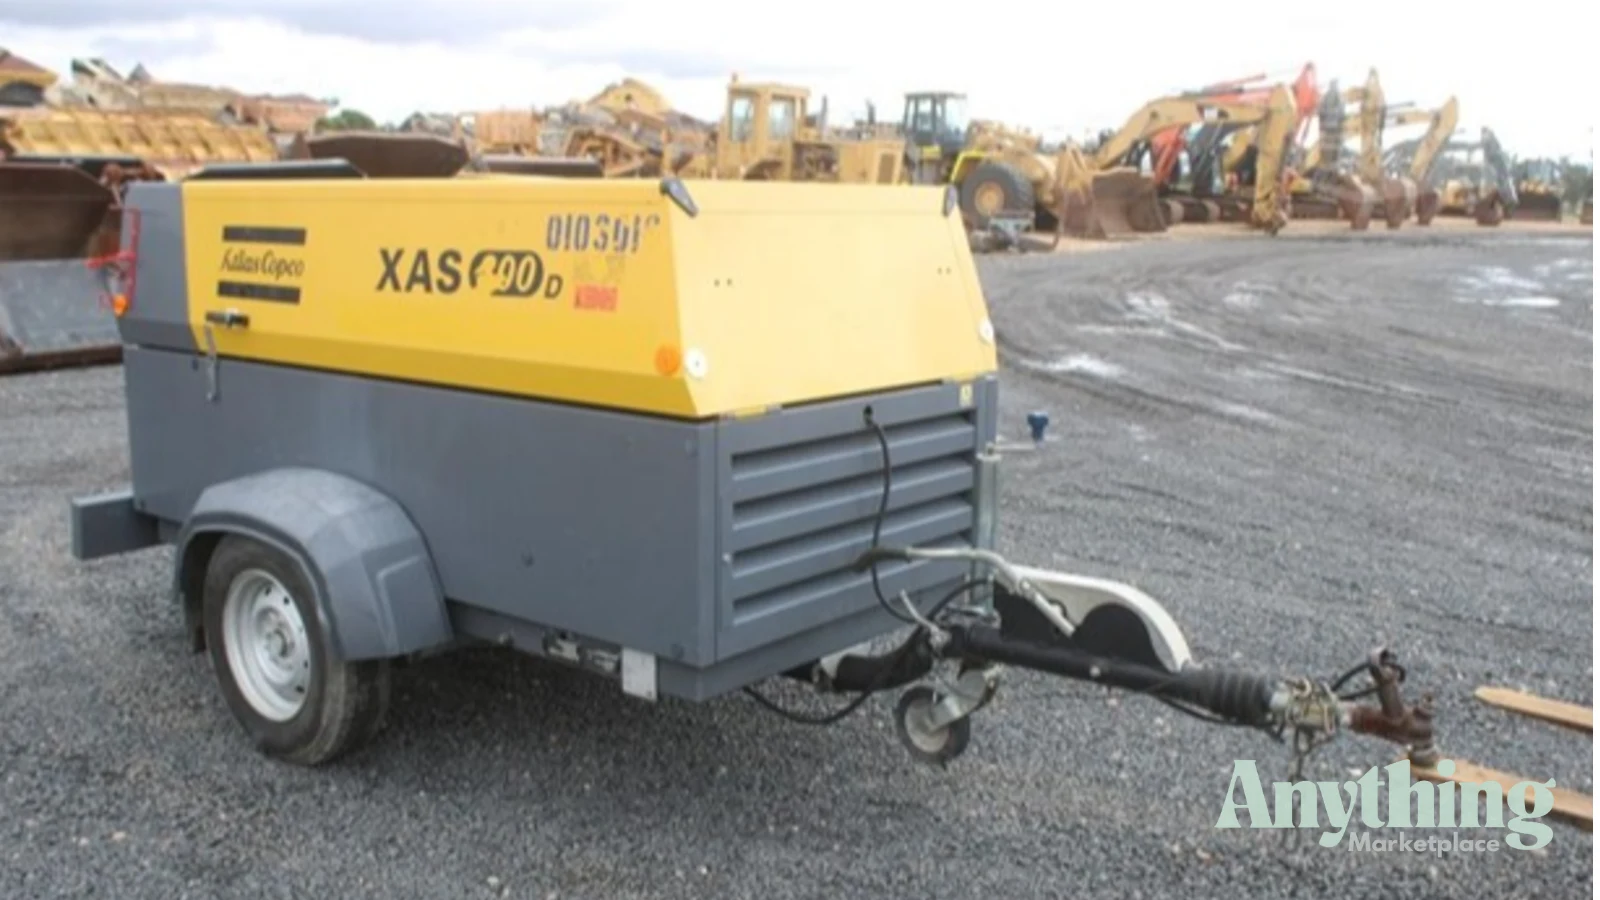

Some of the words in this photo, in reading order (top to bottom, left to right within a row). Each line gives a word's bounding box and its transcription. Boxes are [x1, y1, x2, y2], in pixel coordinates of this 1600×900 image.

[220, 247, 259, 273] Atlas
[261, 248, 305, 281] Copco
[376, 248, 462, 294] XAS
[469, 250, 543, 297] 90
